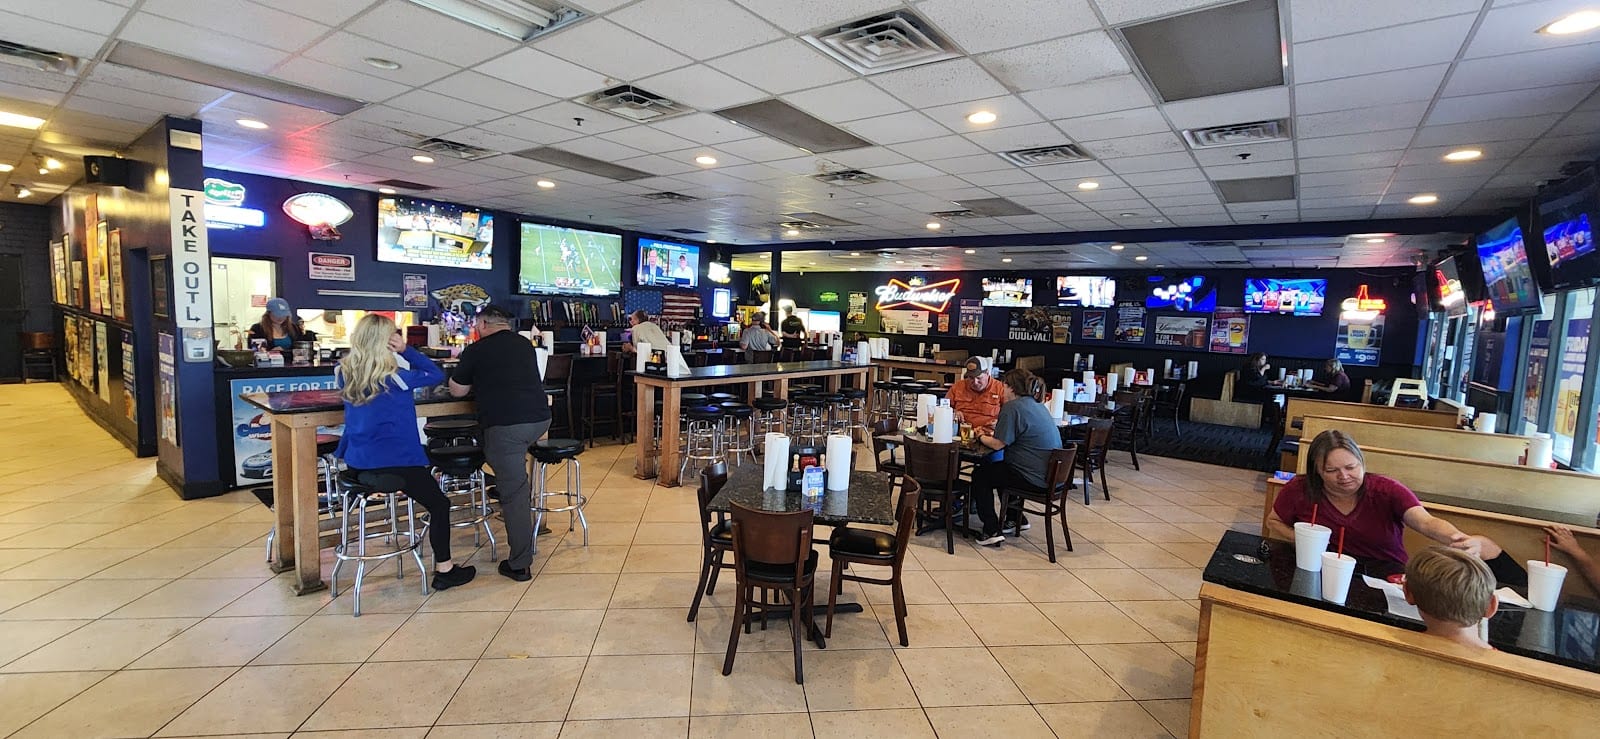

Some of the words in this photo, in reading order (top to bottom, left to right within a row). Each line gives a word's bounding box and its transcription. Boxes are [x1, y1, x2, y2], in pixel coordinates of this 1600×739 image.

[181, 194, 198, 253] TAKE
[183, 261, 200, 304] OUT
[875, 285, 956, 303] Budweiser
[289, 382, 321, 392] FOR
